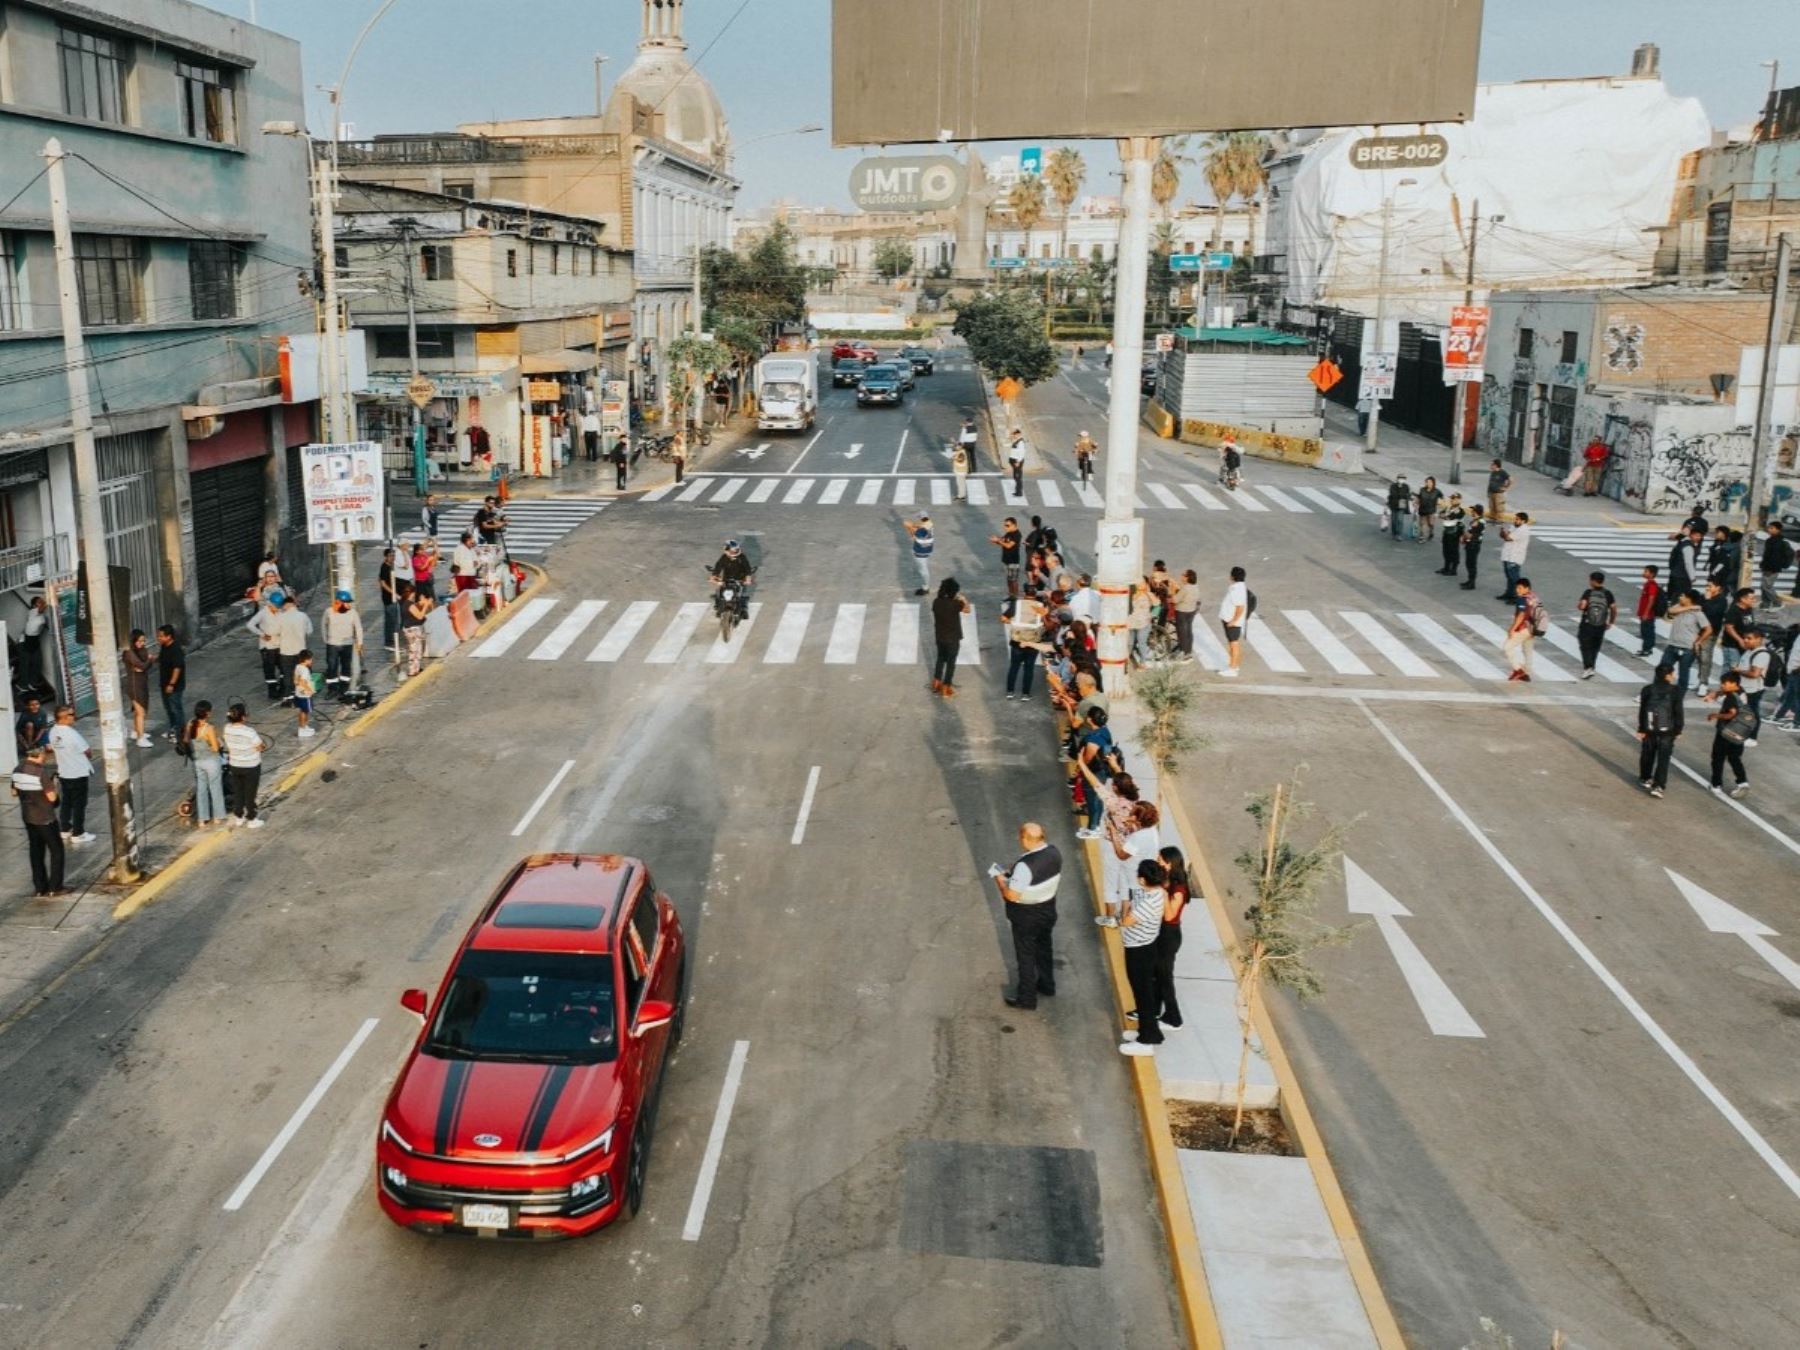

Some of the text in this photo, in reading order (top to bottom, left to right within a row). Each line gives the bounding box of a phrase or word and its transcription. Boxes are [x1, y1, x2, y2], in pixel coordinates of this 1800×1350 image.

[1357, 143, 1442, 161] BRE-002
[860, 167, 919, 194] JMT
[860, 193, 919, 205] outdoors
[1449, 335, 1472, 352] 23
[312, 496, 372, 506] DIPUTADOS
[336, 502, 362, 511] LIMA
[341, 518, 349, 535] 1
[358, 515, 376, 534] 10
[1111, 534, 1130, 549] 20
